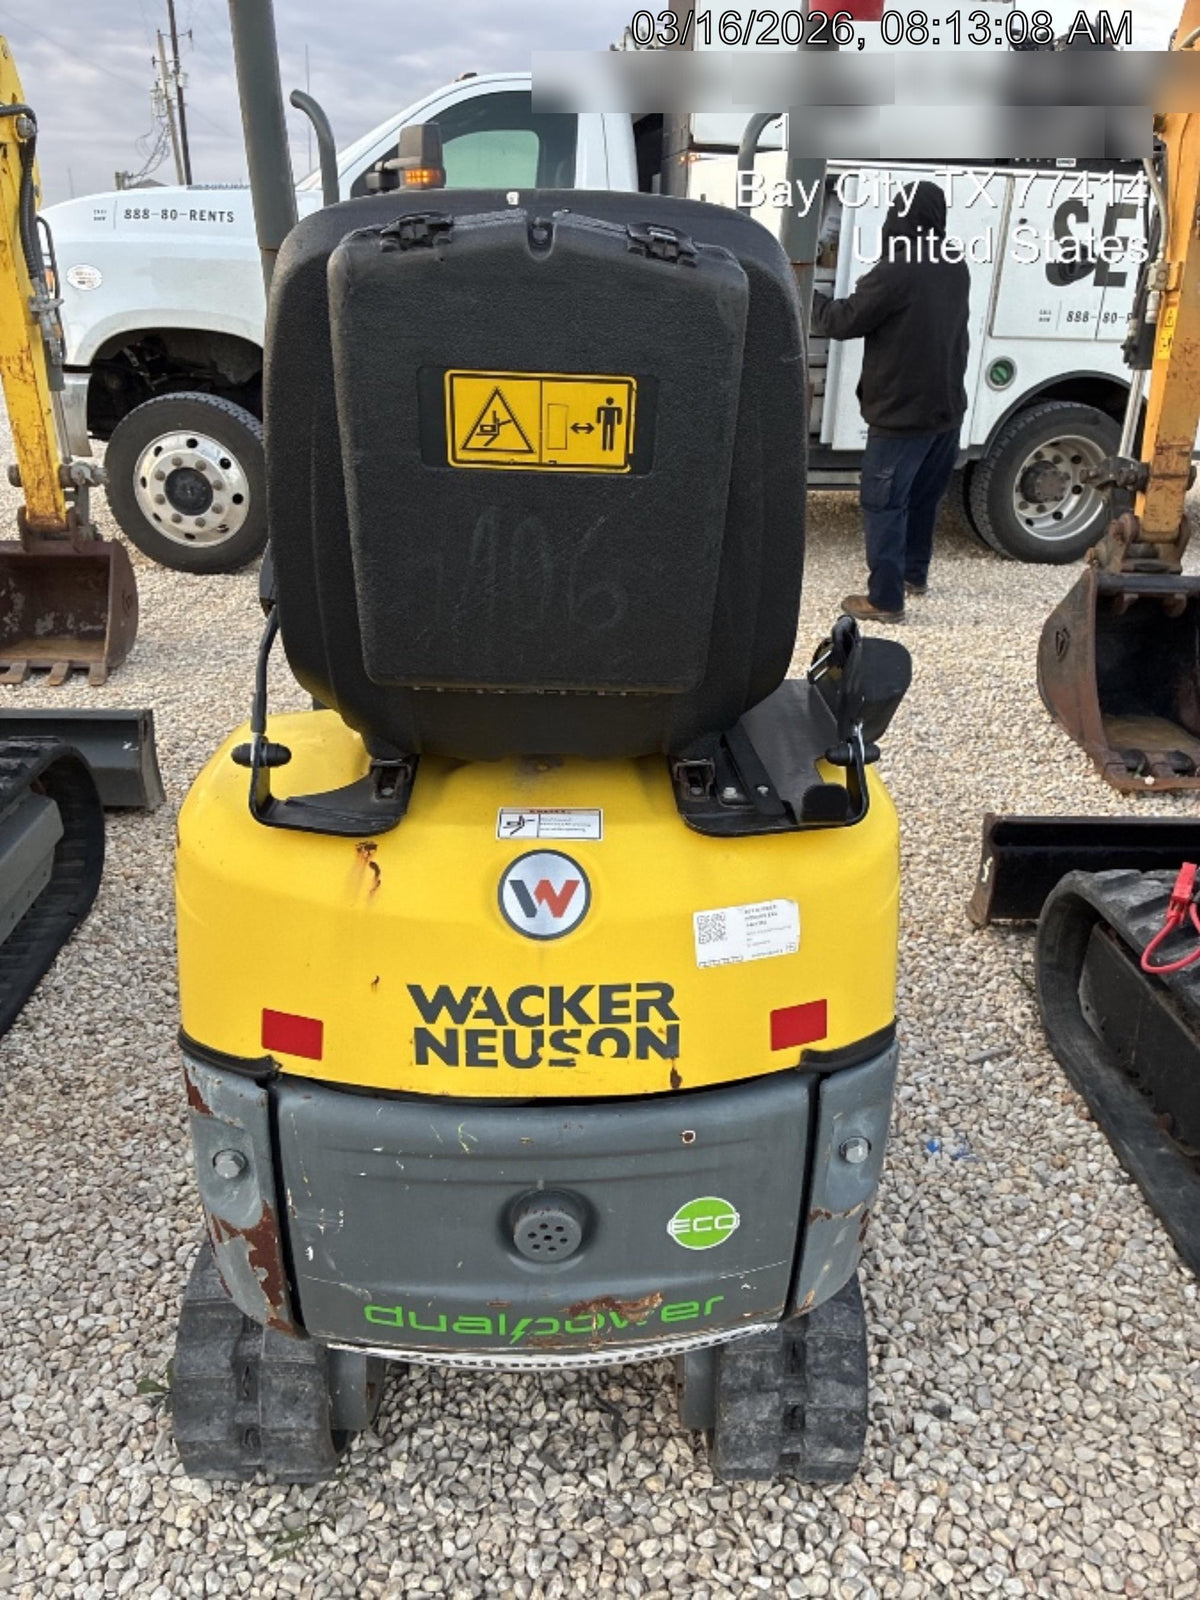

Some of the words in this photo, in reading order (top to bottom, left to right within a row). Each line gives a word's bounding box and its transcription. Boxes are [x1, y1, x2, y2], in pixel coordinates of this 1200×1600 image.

[124, 208, 234, 222] 888-80-RENTS
[407, 982, 680, 1026] WACKER
[413, 1024, 680, 1069] NEUSON
[667, 1212, 739, 1235] ECO
